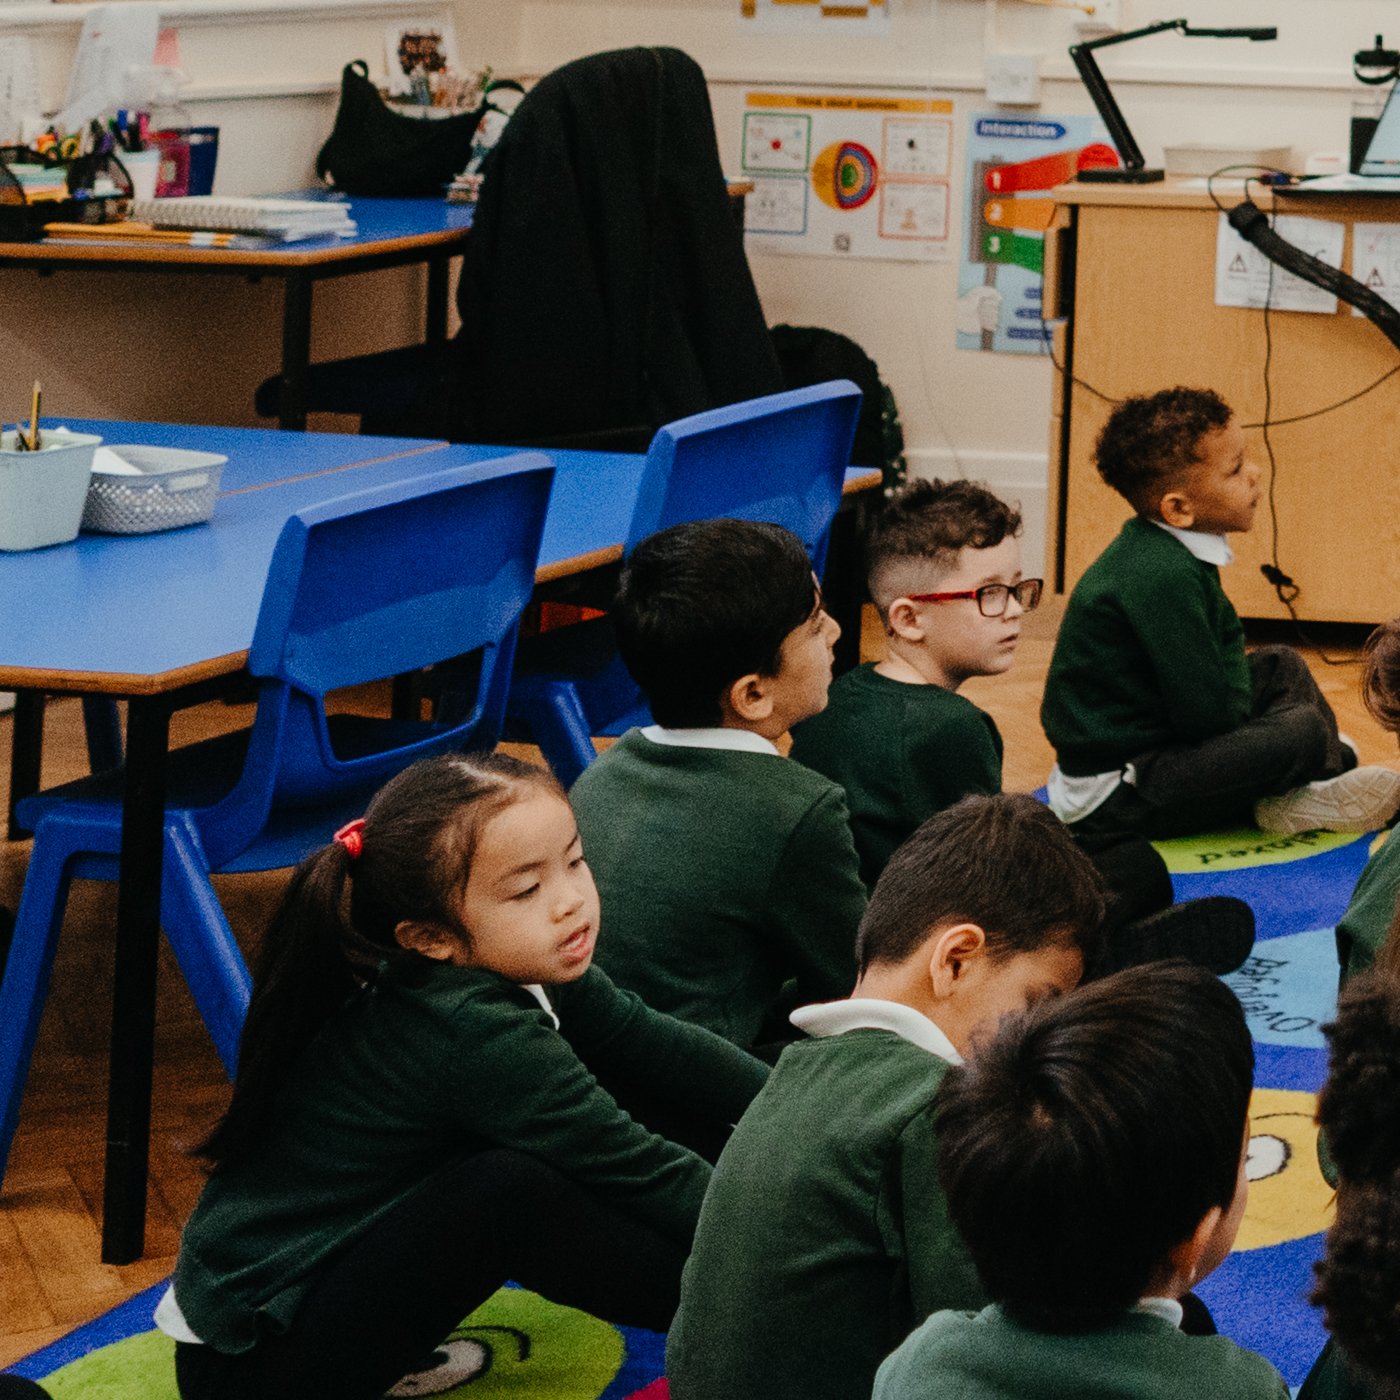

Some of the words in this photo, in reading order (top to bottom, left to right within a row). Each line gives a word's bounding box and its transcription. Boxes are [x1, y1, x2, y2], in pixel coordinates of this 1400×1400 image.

[991, 172, 1000, 188] 1
[990, 205, 1002, 221] 2
[988, 236, 1001, 253] 3
